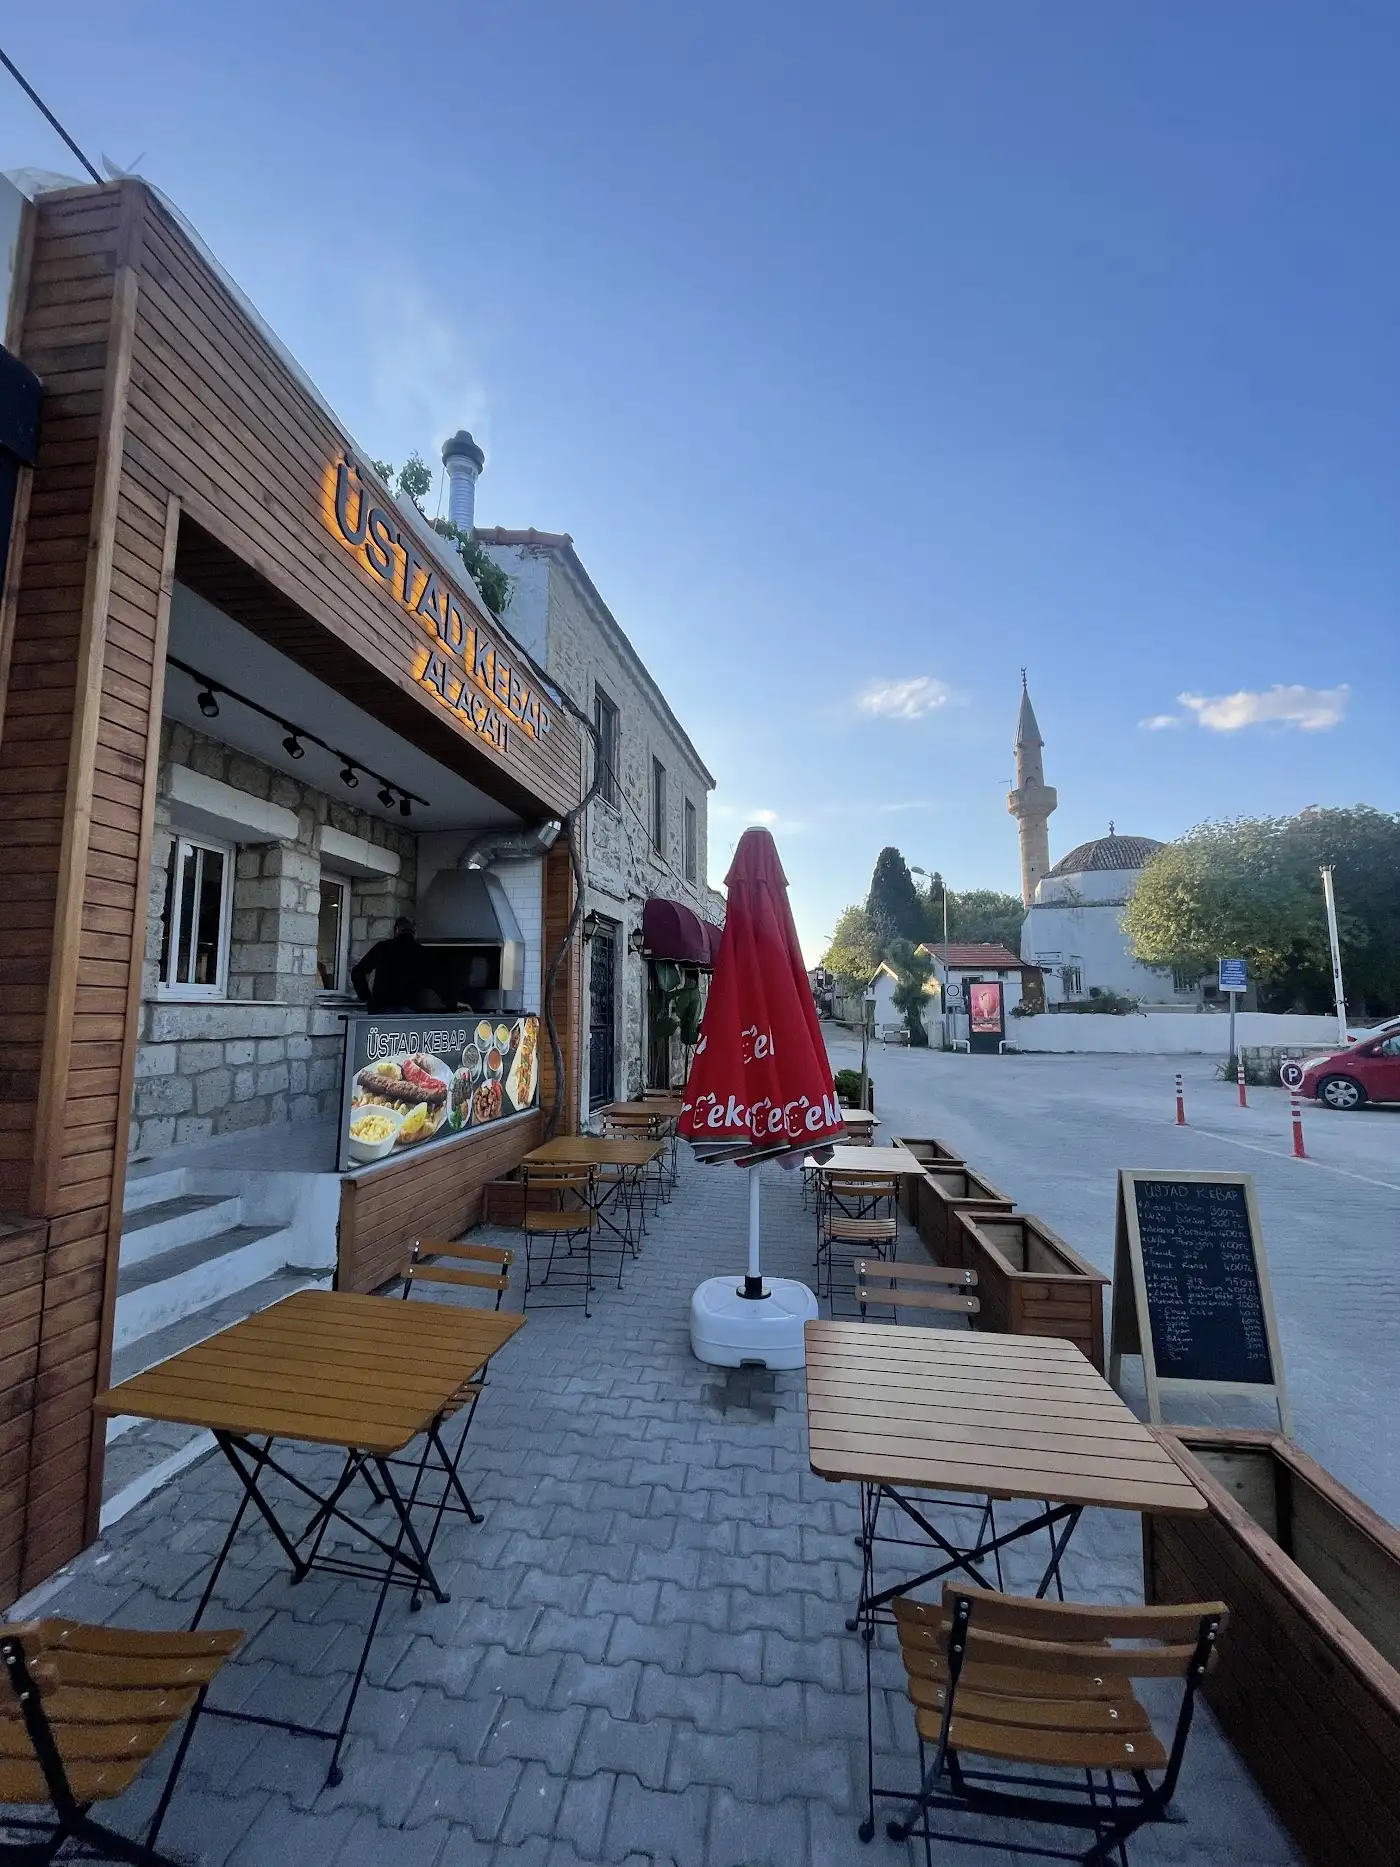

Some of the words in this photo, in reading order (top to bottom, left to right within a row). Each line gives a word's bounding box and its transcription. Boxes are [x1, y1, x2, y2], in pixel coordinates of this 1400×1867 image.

[335, 453, 466, 655] ÜSTAD
[473, 627, 551, 741] KEBAP
[422, 651, 509, 753] ALAÇATI
[367, 1027, 420, 1060] ÜSTAD
[422, 1029, 467, 1054] KEBAP
[1288, 1068, 1299, 1082] P
[1144, 1182, 1189, 1199] ÜSTAD
[1196, 1187, 1239, 1201] KEBAP
[1147, 1225, 1174, 1235] Adana
